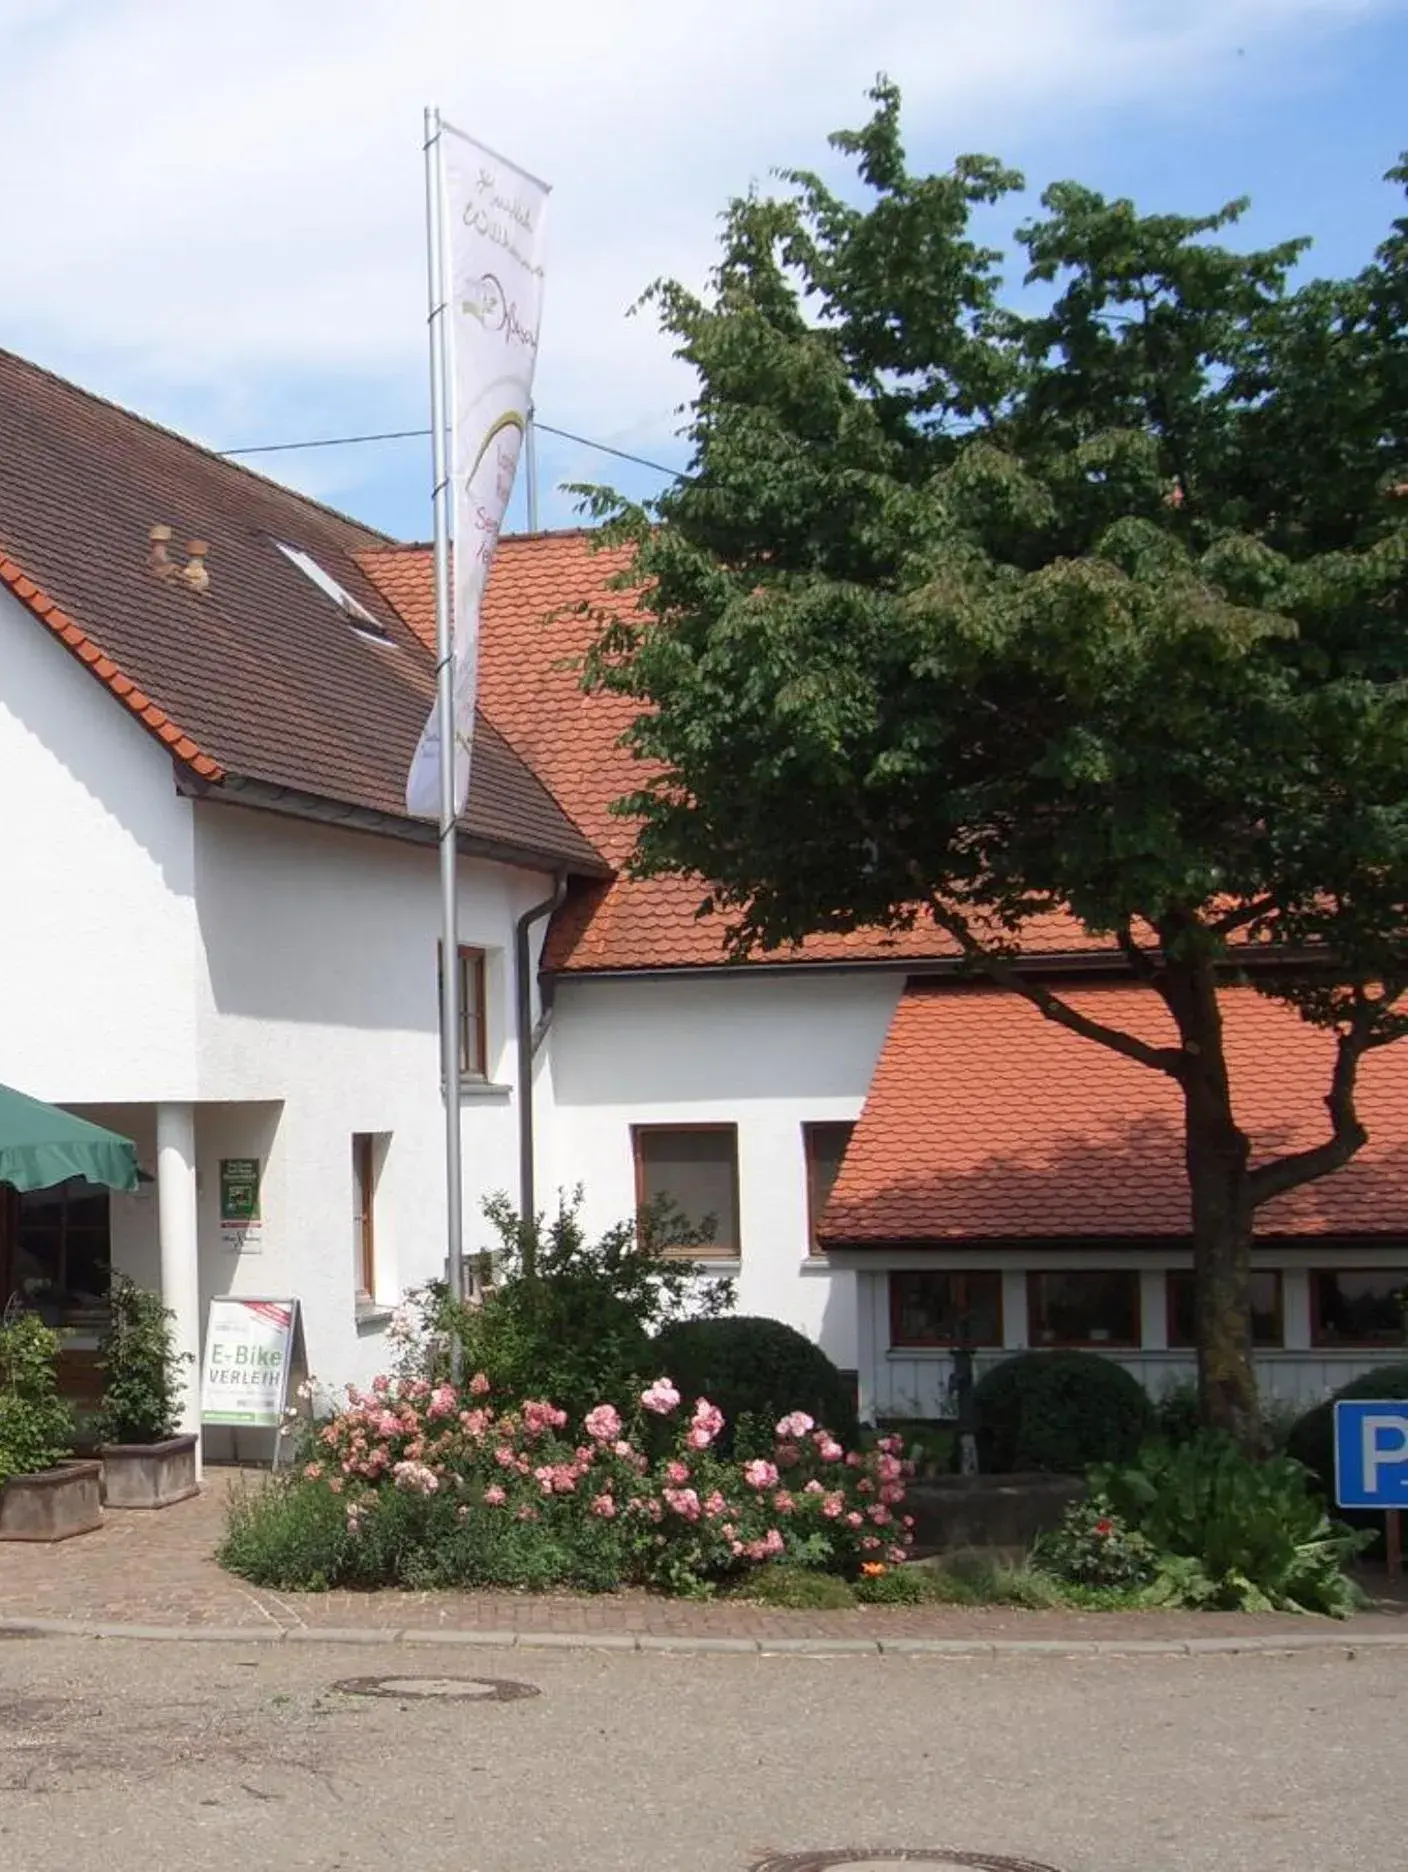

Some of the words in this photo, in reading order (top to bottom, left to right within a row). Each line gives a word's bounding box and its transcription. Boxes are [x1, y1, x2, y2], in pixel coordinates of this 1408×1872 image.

[212, 1343, 283, 1366] E-Bike
[209, 1368, 281, 1386] VERLEIH
[1361, 1415, 1408, 1493] P
